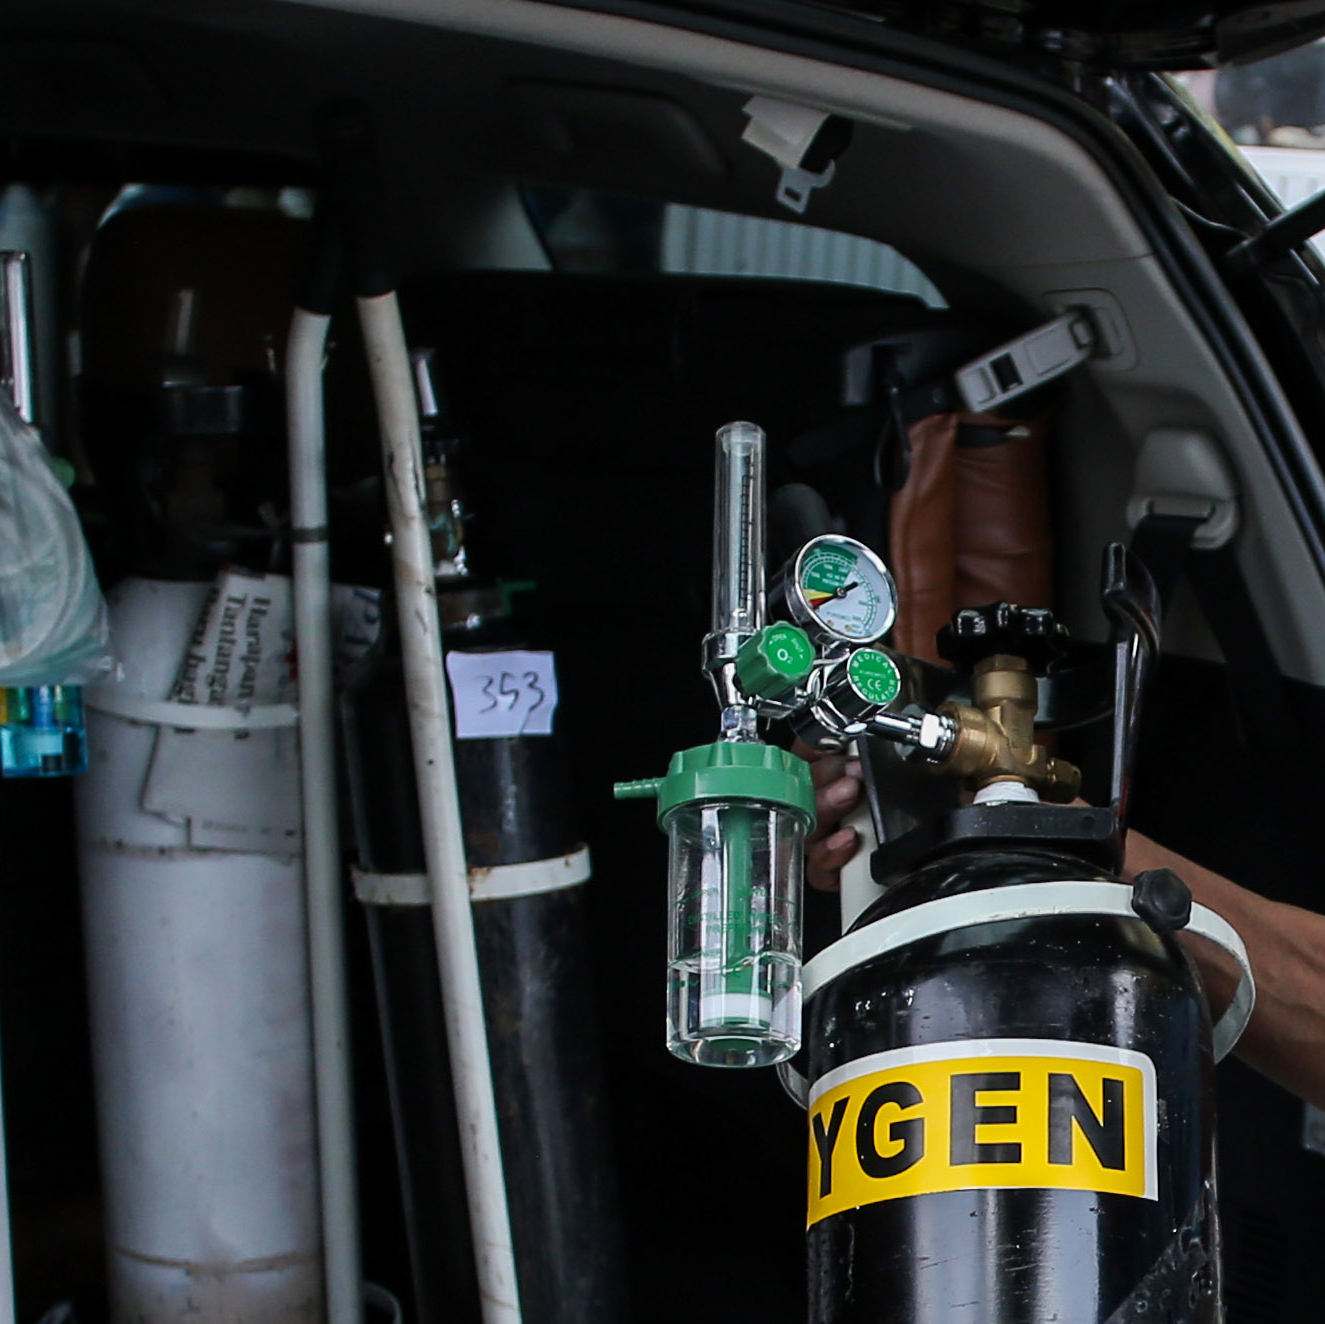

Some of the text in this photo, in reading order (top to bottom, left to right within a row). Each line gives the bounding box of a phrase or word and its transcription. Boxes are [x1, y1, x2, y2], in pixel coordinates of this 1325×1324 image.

[852, 652, 893, 674] MEDICAL
[474, 671, 545, 714] 353
[812, 1071, 1126, 1200] YGEN
